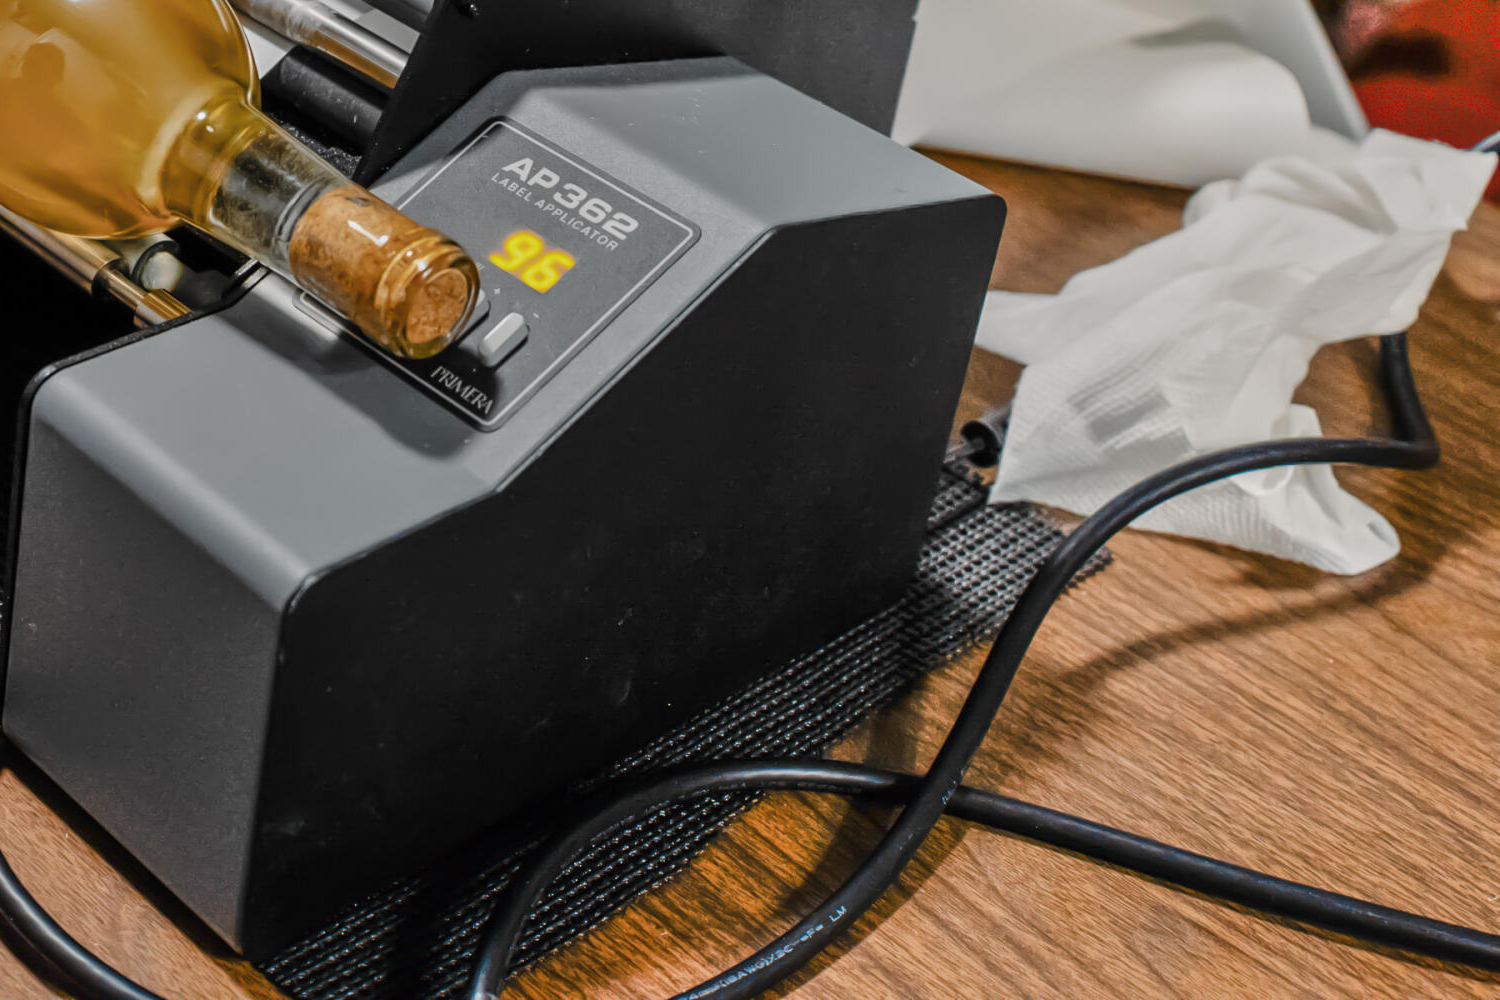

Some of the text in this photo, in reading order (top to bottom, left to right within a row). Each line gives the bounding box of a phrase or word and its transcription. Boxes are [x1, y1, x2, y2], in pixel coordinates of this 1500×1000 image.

[491, 172, 619, 252] LABEL APPLICATOR
[502, 157, 640, 241] AP362
[489, 229, 576, 294] 96
[430, 365, 495, 415] PRIMERA
